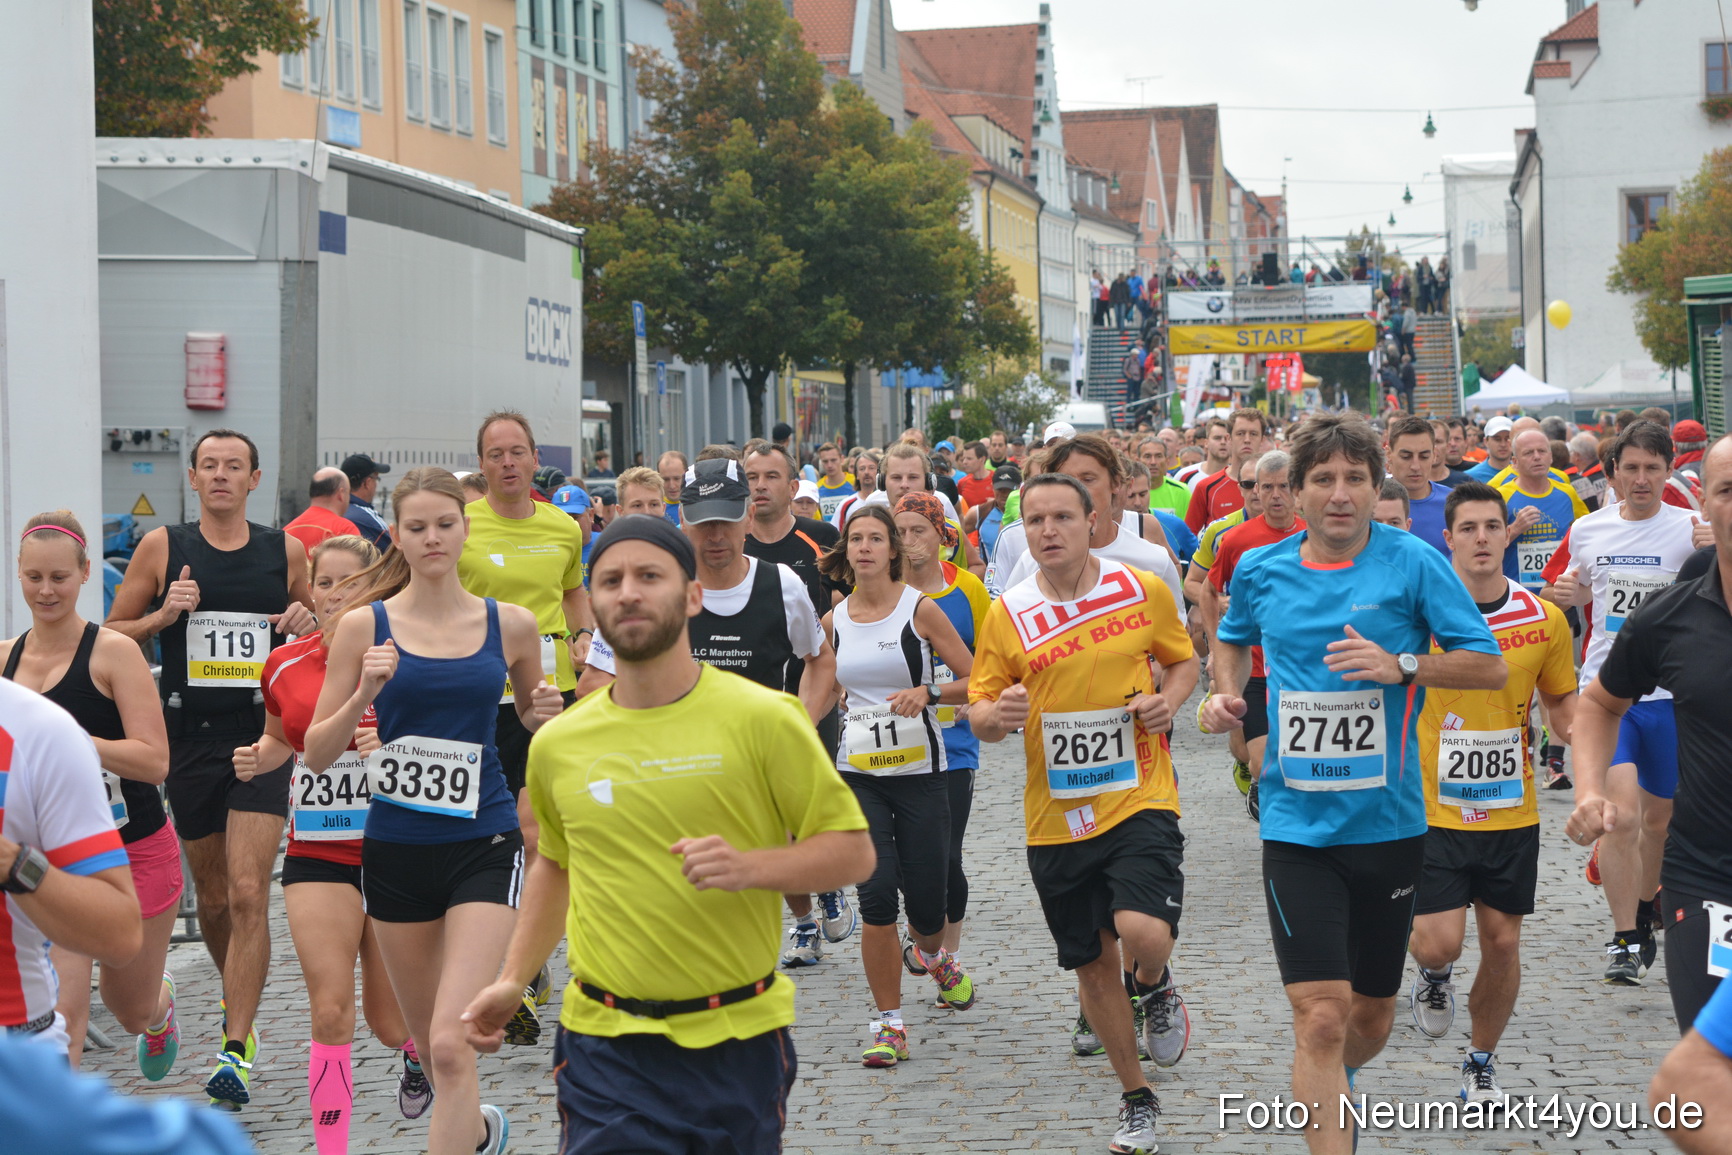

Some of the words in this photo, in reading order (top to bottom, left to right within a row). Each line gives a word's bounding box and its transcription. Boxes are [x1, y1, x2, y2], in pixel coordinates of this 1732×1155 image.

[525, 296, 571, 367] BOCK
[1236, 328, 1307, 346] START
[1608, 577, 1631, 587] PARTL
[1632, 580, 1669, 589] Neumarkt
[189, 618, 216, 627] PARTL
[218, 619, 256, 628] Neumarkt
[204, 630, 255, 658] 119
[1028, 635, 1085, 675] MAX
[1089, 611, 1152, 645] BÖGL
[1499, 628, 1550, 652] BÖGL
[689, 648, 707, 657] LLC
[709, 648, 752, 657] Marathon
[203, 664, 254, 678] Christoph
[1281, 700, 1311, 711] PARTL
[1313, 701, 1365, 711] Neumarkt
[849, 713, 871, 722] PARTL
[872, 710, 899, 719] Neuma
[1043, 721, 1072, 729] PARTL
[1074, 717, 1118, 729] Neumarkt
[869, 720, 898, 748] 11
[1288, 715, 1375, 752] 2742
[1442, 738, 1471, 747] PARTL
[1472, 736, 1511, 747] Neumarkt
[379, 744, 409, 755] ARTL
[411, 745, 464, 762] Neumarkt
[1052, 727, 1124, 765] 2621
[325, 759, 365, 770] eumarkt
[869, 753, 905, 767] Milena
[1447, 748, 1517, 779] 2085
[1067, 768, 1114, 787] Michael
[1311, 763, 1351, 777] Klaus
[378, 758, 470, 804] 3339
[300, 772, 372, 807] 2344
[1461, 784, 1502, 799] Manuel
[321, 815, 352, 828] Julia
